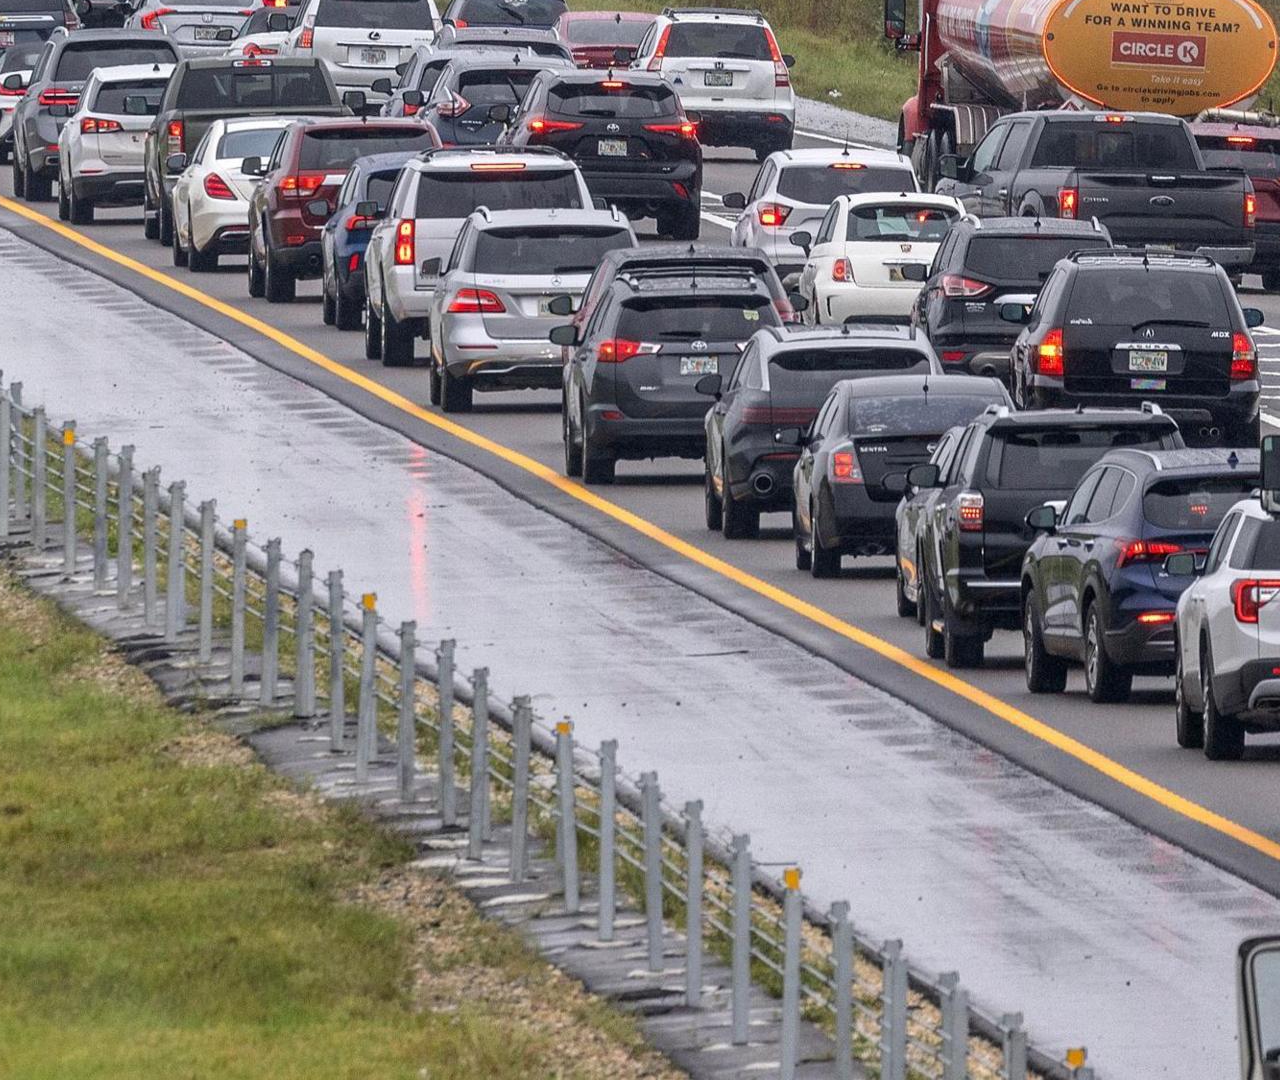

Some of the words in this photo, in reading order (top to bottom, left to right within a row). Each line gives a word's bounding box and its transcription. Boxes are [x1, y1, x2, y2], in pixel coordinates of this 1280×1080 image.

[1111, 2, 1149, 14] WANT
[1155, 5, 1171, 15] TO
[1176, 7, 1216, 18] DRIVE
[1085, 14, 1112, 26] FOR
[1117, 17, 1126, 27] A
[1131, 18, 1191, 31] WINNING
[1196, 21, 1240, 33] TEAM?
[1119, 42, 1174, 58] CIRCLE
[1096, 83, 1109, 91] Go
[1111, 83, 1120, 91] to
[1150, 75, 1171, 84] Take
[1182, 77, 1204, 87] easy
[1152, 97, 1176, 105] apply
